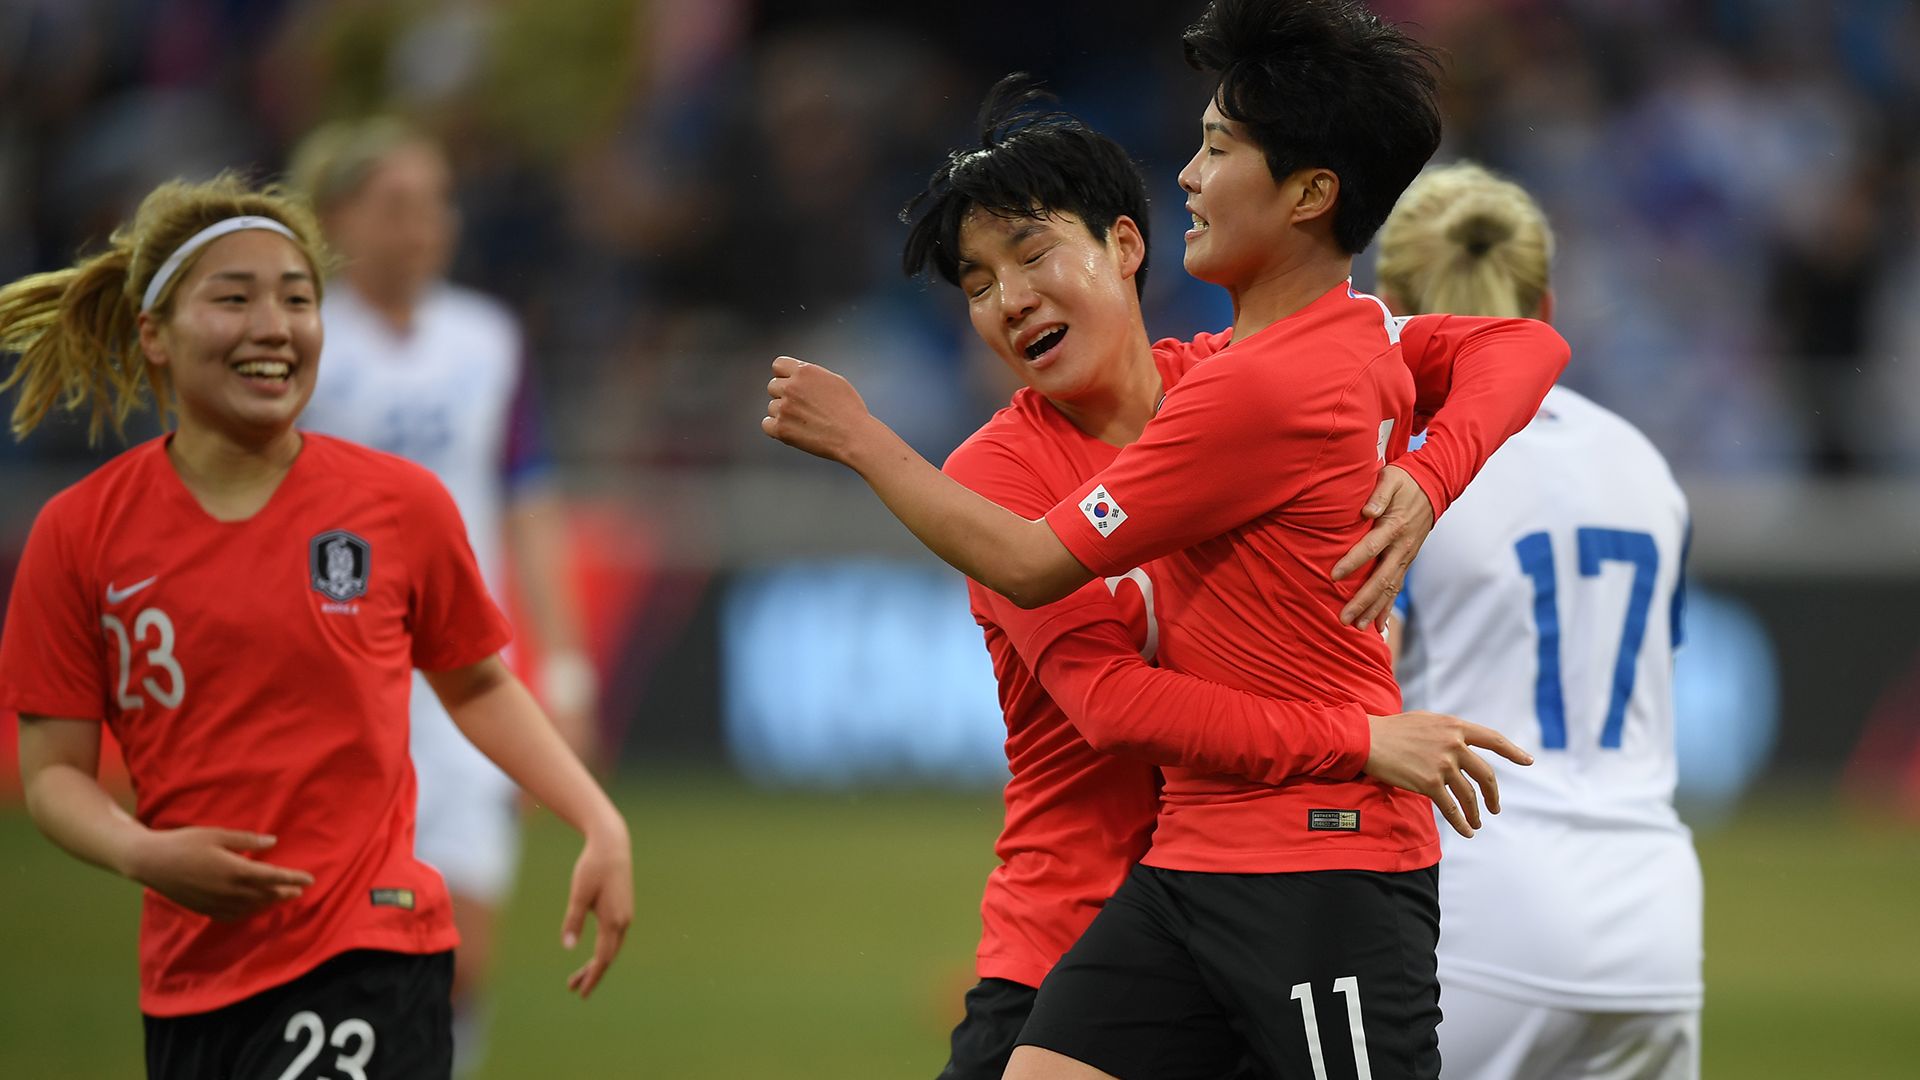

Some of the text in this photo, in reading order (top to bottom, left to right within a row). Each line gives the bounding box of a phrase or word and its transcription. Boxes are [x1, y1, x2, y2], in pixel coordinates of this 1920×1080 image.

[101, 607, 185, 710] 23
[1515, 527, 1659, 749] 17
[278, 1010, 376, 1080] 23
[1290, 976, 1372, 1080] 11
